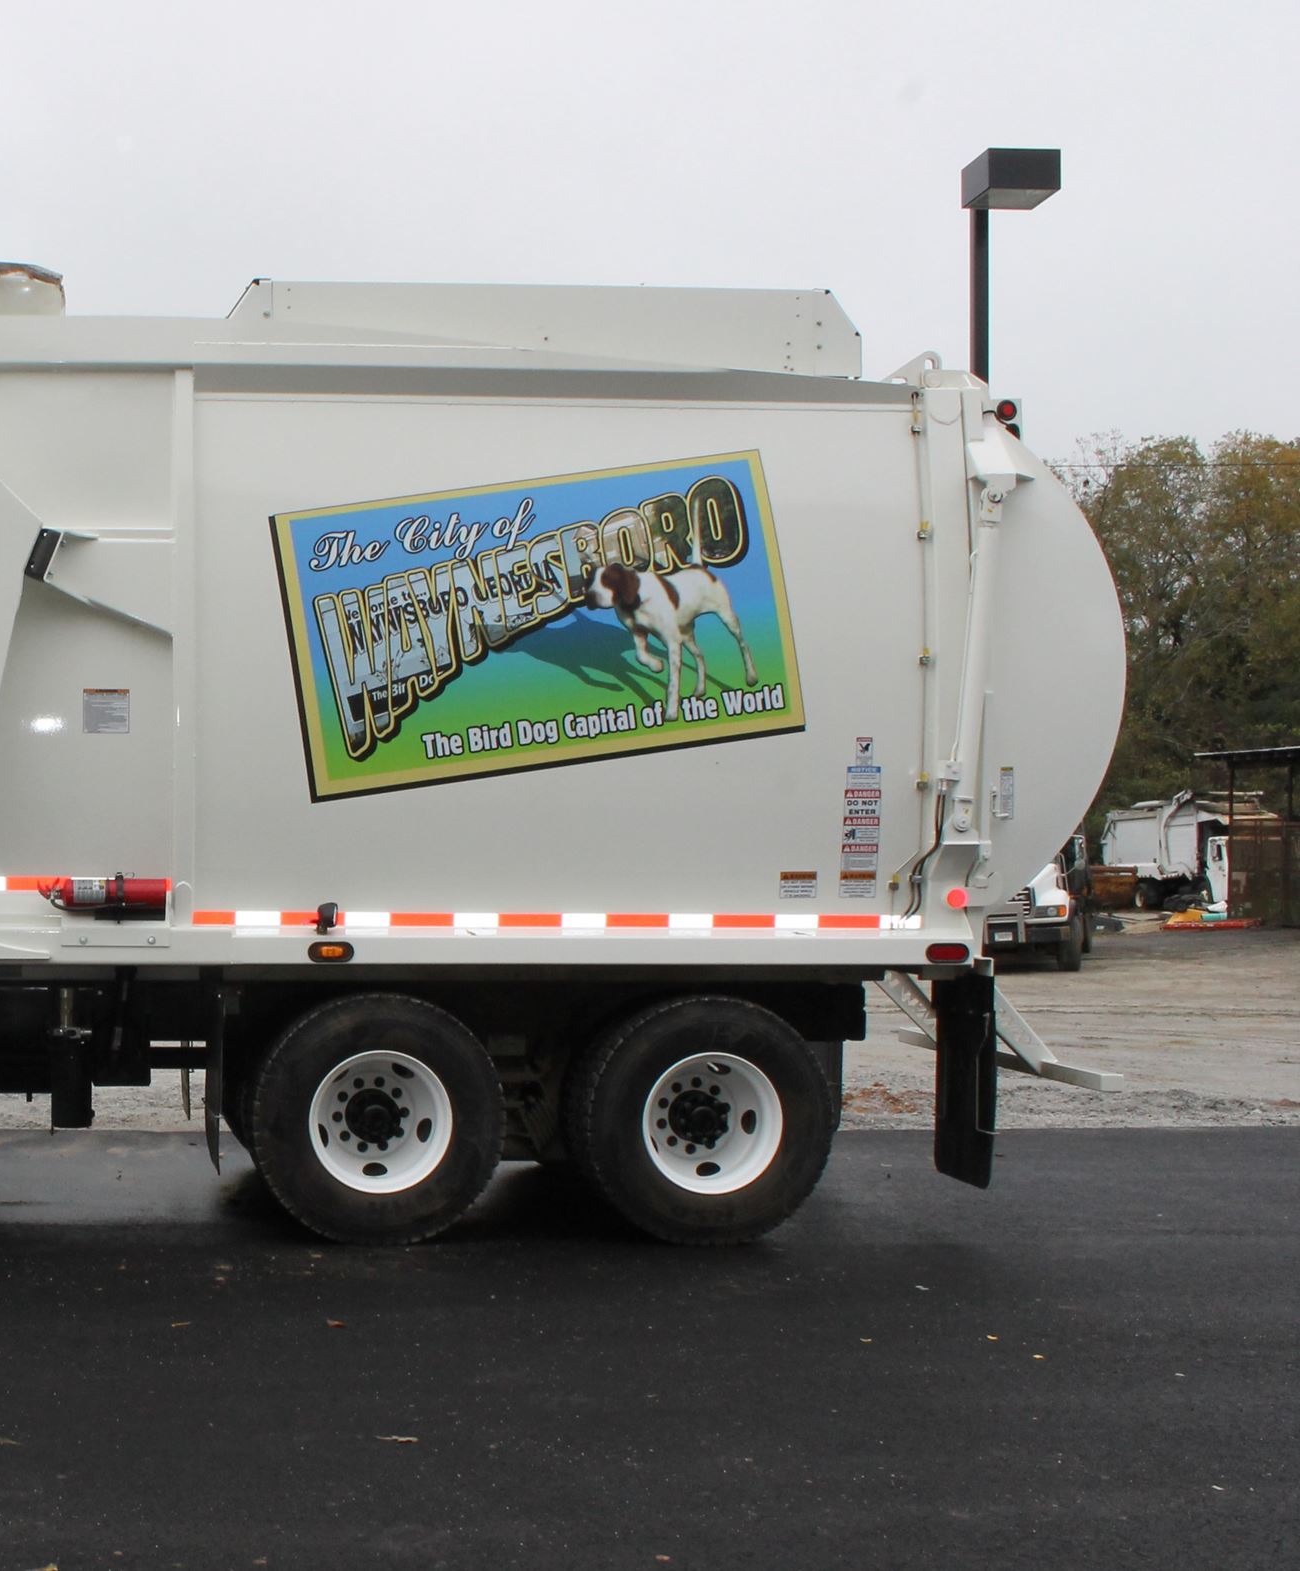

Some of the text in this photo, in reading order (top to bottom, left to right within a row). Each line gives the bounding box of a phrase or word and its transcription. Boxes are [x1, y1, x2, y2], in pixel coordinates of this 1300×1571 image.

[309, 497, 536, 571] The City of
[313, 475, 749, 760] WAYNESBORO
[422, 684, 785, 759] The Bird Dog Capital of the World
[853, 790, 880, 798] DANGER
